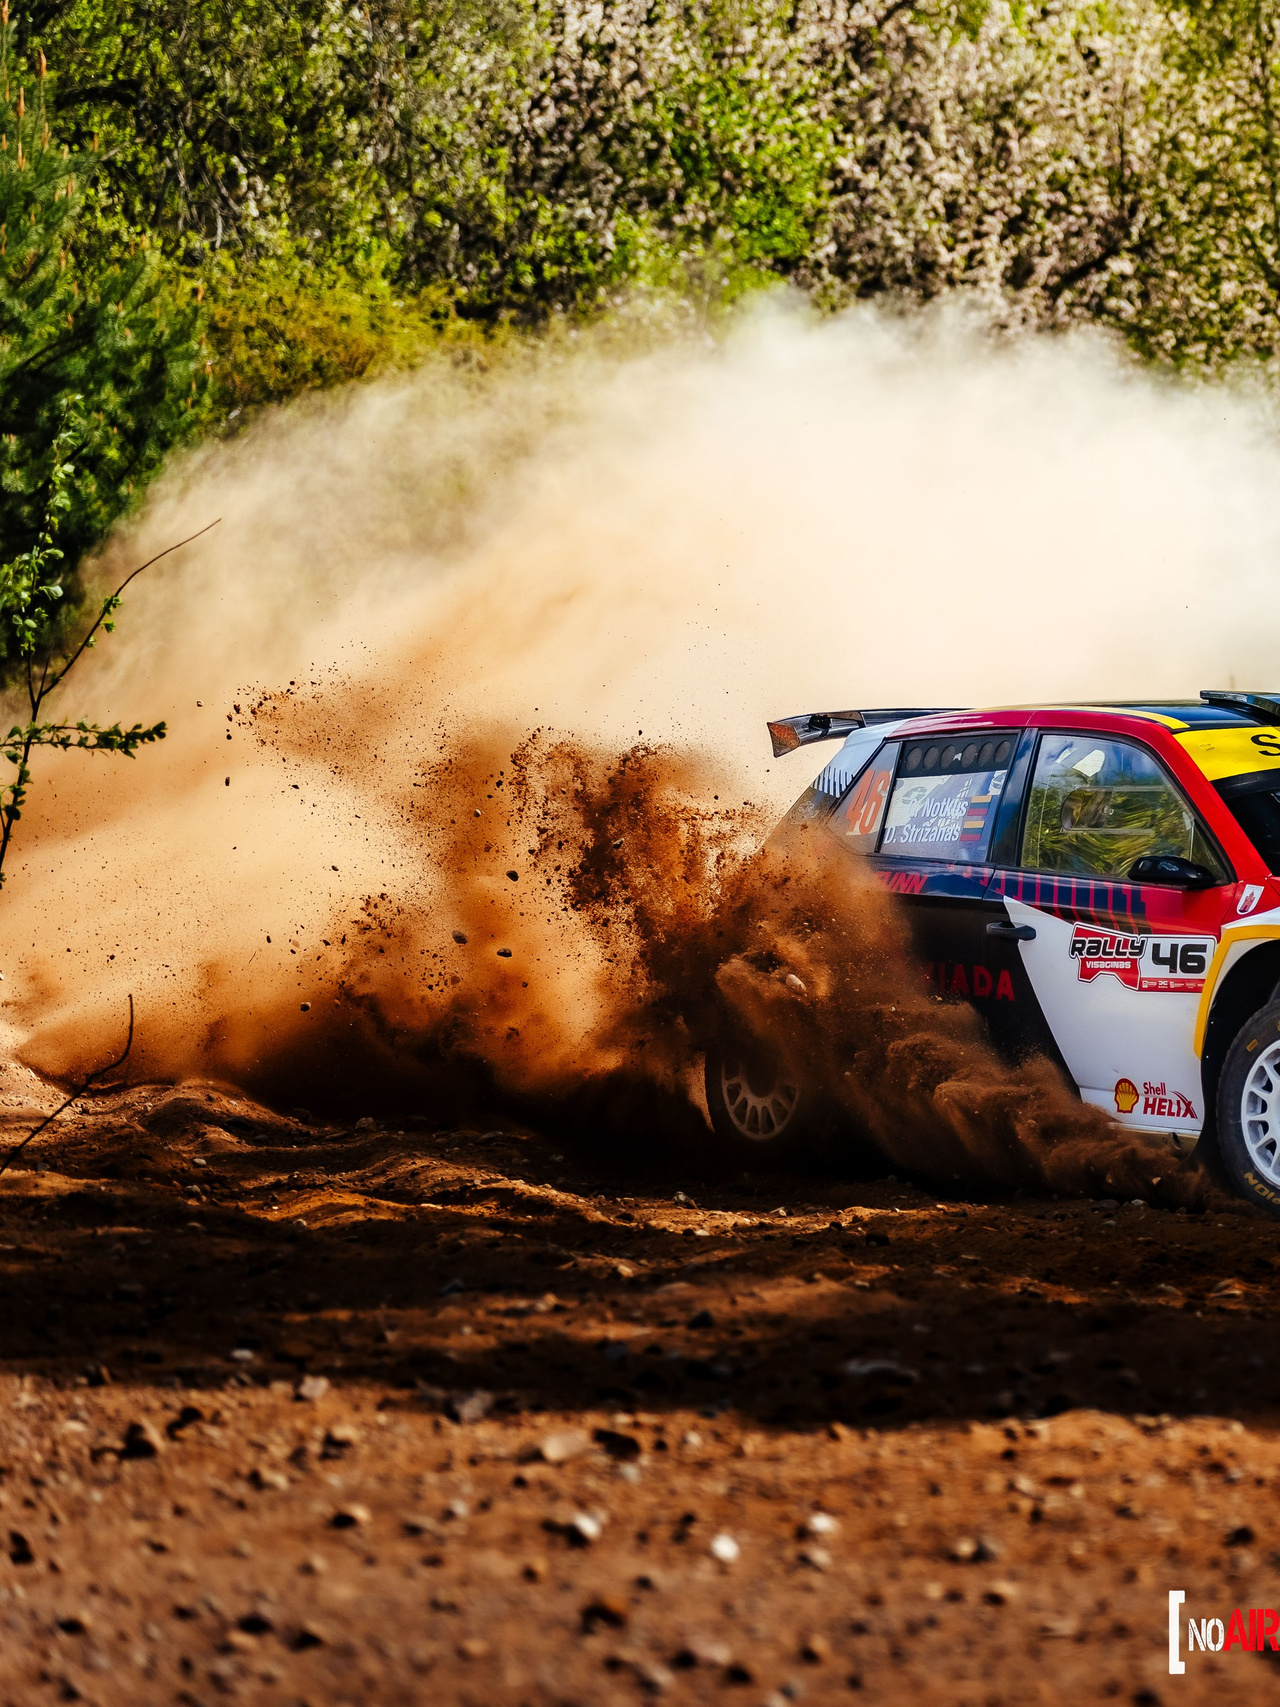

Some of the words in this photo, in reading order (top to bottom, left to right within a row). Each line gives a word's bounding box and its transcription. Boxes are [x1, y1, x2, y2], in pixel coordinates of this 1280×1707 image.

[846, 769, 891, 834] 46
[883, 825, 897, 844] D.
[1152, 943, 1208, 974] 46
[1142, 1081, 1167, 1096] Shell
[1142, 1092, 1198, 1119] HELIX
